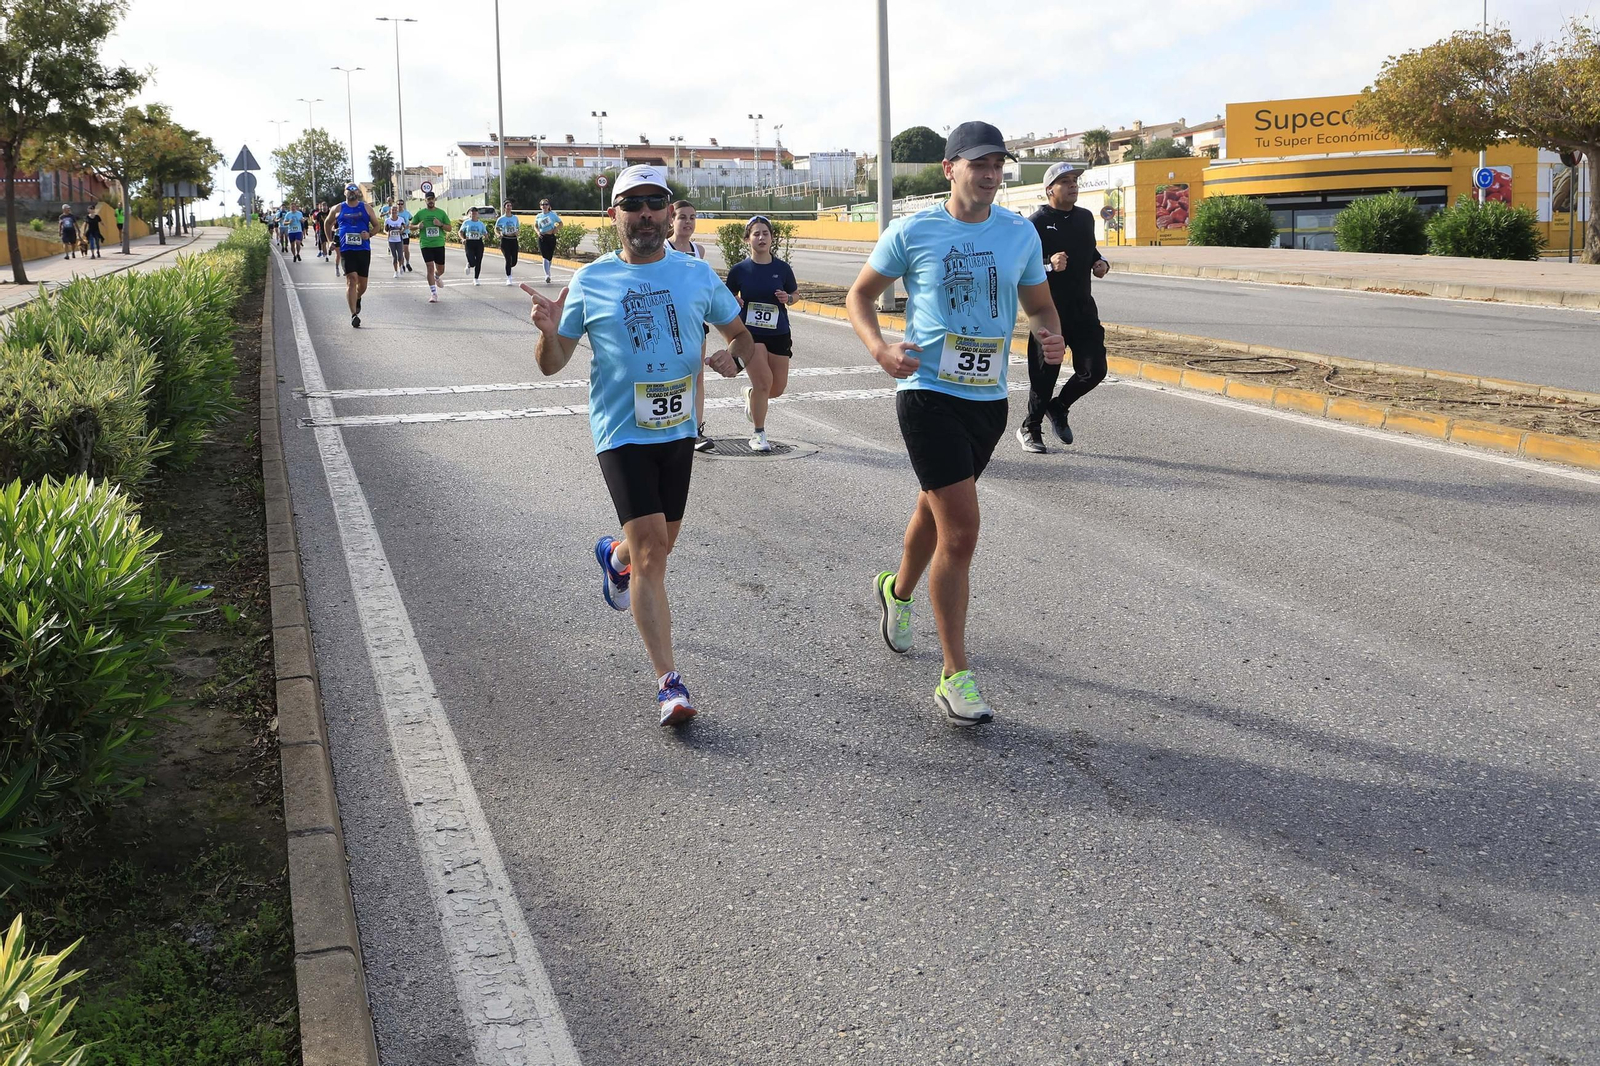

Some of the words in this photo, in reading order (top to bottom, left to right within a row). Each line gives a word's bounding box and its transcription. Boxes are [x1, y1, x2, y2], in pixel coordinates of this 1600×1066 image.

[1255, 137, 1270, 148] Tu
[1274, 135, 1313, 149] Super
[1317, 130, 1390, 145] Económico
[961, 242, 975, 253] XXV
[969, 255, 996, 268] URBANA
[638, 282, 651, 294] XXV
[988, 266, 998, 319] ALGECIRAS
[645, 293, 673, 307] URBANA
[754, 311, 771, 321] 30
[666, 304, 683, 355] ALGECIRAS
[955, 345, 972, 353] CIUDAD
[957, 352, 992, 373] 35
[652, 394, 682, 416] 36
